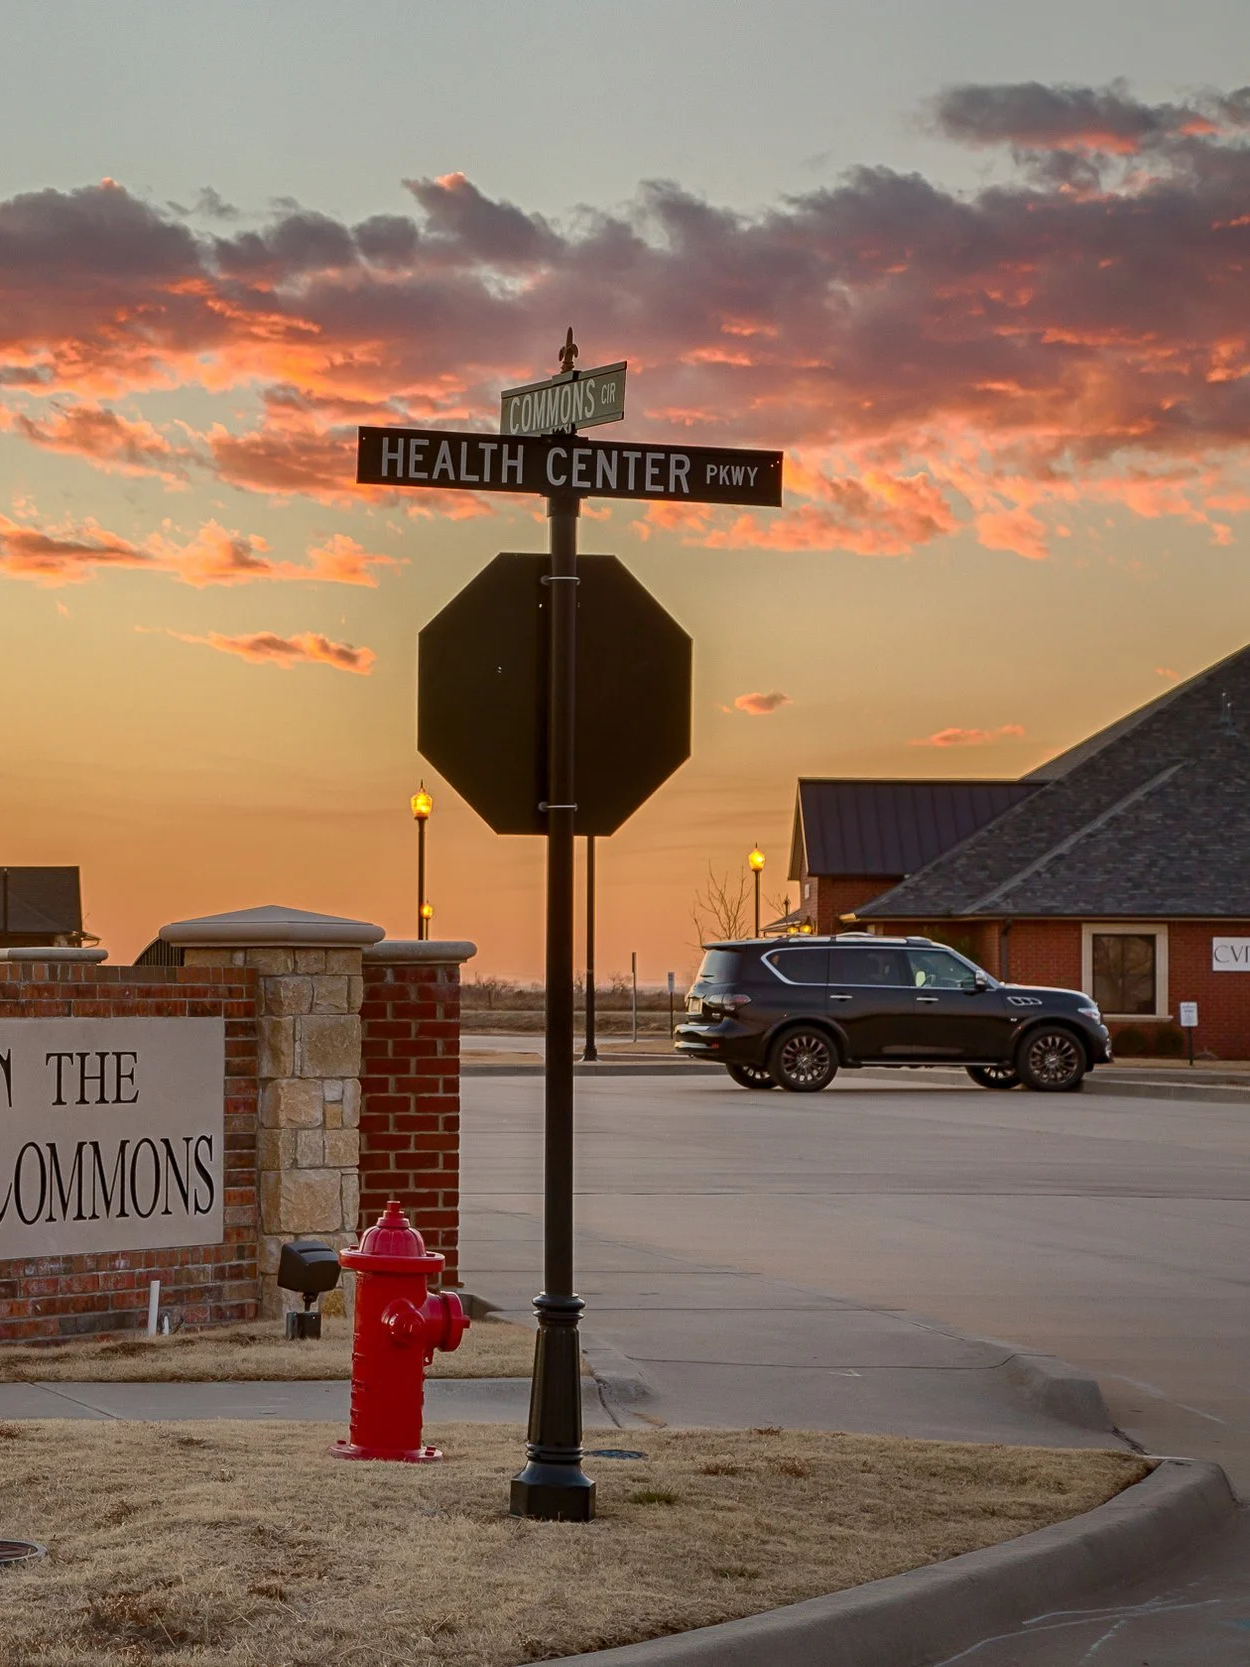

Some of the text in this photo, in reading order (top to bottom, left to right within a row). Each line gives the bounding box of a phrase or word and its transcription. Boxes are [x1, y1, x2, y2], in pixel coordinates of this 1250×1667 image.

[510, 379, 617, 435] COMMONS CIR
[380, 437, 759, 494] HEALTH CENTER PKWY
[1214, 944, 1250, 963] CV
[45, 1051, 140, 1106] THE
